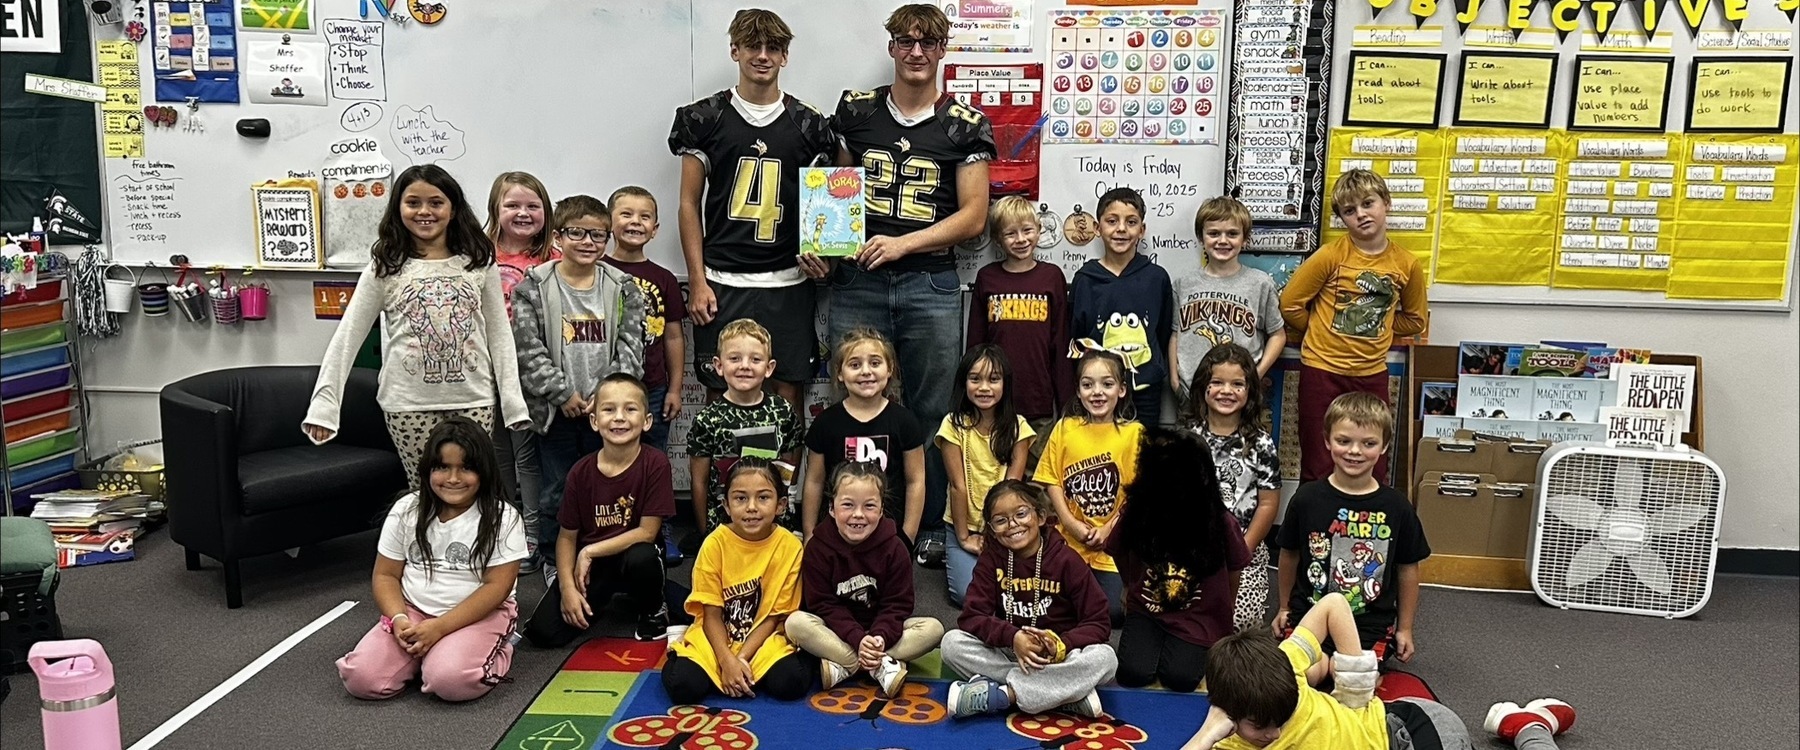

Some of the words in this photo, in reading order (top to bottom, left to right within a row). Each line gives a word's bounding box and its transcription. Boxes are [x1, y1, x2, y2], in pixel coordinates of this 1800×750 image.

[964, 4, 1006, 14] Summer
[326, 23, 358, 34] Change
[362, 25, 381, 38] your
[1250, 29, 1280, 42] gym
[1156, 32, 1164, 44] 2
[1180, 32, 1188, 44] 3
[1201, 32, 1210, 43] 4
[1370, 28, 1406, 46] Reading
[1604, 32, 1632, 48] Math
[1702, 33, 1734, 47] Science
[338, 42, 368, 60] Stop
[1244, 47, 1280, 57] snack
[1107, 52, 1114, 64] 7
[1130, 55, 1138, 68] 8
[1154, 54, 1162, 66] 9
[1175, 54, 1188, 66] 10
[1199, 56, 1212, 66] 11
[1358, 61, 1366, 70] I
[270, 64, 303, 72] Shaffer
[338, 62, 369, 74] Think
[1582, 66, 1592, 75] I
[1699, 68, 1710, 77] I
[340, 76, 374, 89] Choose
[1055, 78, 1068, 88] 12
[1078, 77, 1091, 88] 13
[1102, 78, 1115, 88] 14
[1127, 78, 1139, 90] 15
[1150, 78, 1163, 90] 16
[1173, 78, 1186, 90] 17
[1198, 78, 1211, 90] 18
[1247, 82, 1291, 92] calendar
[1358, 78, 1383, 86] read
[1391, 78, 1421, 87] about
[1503, 80, 1533, 89] about
[61, 81, 98, 98] Shaffer
[1584, 85, 1602, 93] use
[1611, 84, 1641, 96] place
[1702, 89, 1720, 98] use
[1729, 87, 1755, 97] tools
[1762, 87, 1771, 97] to
[1056, 100, 1068, 110] 19
[1077, 101, 1090, 111] 20
[1102, 101, 1114, 110] 21
[1124, 101, 1137, 112] 22
[1150, 101, 1162, 111] 23
[1172, 100, 1184, 111] 24
[1197, 102, 1210, 112] 25
[1250, 101, 1284, 110] math
[1577, 100, 1607, 110] value
[1614, 101, 1622, 109] to
[1630, 98, 1649, 110] add
[1696, 103, 1711, 114] do
[396, 113, 430, 130] Lunch
[1259, 118, 1289, 128] lunch
[1054, 122, 1067, 133] 26
[1078, 123, 1090, 134] 27
[1101, 122, 1114, 133] 28
[1123, 122, 1136, 133] 29
[1146, 122, 1158, 134] 30
[1171, 122, 1184, 132] 31
[402, 131, 427, 145] with
[430, 130, 450, 142] the
[1245, 136, 1287, 146] recess
[331, 138, 377, 154] cookie
[412, 144, 448, 156] teacher
[1357, 138, 1394, 155] Vocabulary
[1464, 138, 1508, 154] Vocabulary
[1511, 139, 1537, 152] Words
[1582, 142, 1620, 156] Vocabulary
[1253, 151, 1282, 159] reading
[1701, 146, 1743, 160] Vocabulary
[1746, 147, 1769, 161] Words
[322, 163, 390, 176] compliments
[1074, 156, 1116, 178] Today
[1124, 162, 1133, 173] is
[1143, 155, 1181, 179] Friday
[1392, 162, 1414, 173] Work
[1453, 160, 1473, 172] Noun
[1243, 171, 1284, 180] recess
[154, 182, 175, 191] school
[829, 176, 859, 190] LORAX
[862, 149, 940, 222] 22
[1150, 184, 1161, 197] 10,
[1166, 184, 1198, 196] 2025
[1245, 188, 1282, 197] phonics
[728, 156, 784, 242] 4
[1501, 198, 1532, 209] Solution
[1271, 205, 1283, 214] up
[1252, 235, 1294, 247] writing
[1063, 250, 1087, 261] Penny
[321, 291, 328, 302] 1
[339, 292, 347, 302] 2
[1188, 291, 1249, 307] POTTERVILLE
[1180, 300, 1257, 338] VIKINGS
[1528, 359, 1577, 368] TOOLS
[1590, 356, 1624, 364] MATH
[1630, 375, 1650, 388] THE
[1654, 376, 1686, 389] LITTLE
[1470, 387, 1520, 398] MAGNIFICENT
[1537, 388, 1588, 400] MAGNIFICENT
[1628, 388, 1654, 408] RED
[1659, 390, 1684, 409] PEN
[1484, 398, 1505, 407] THING
[1551, 400, 1572, 409] THING
[1610, 417, 1629, 430] THE
[1633, 418, 1666, 432] LITTLE
[1337, 508, 1386, 524] SUPER
[1328, 519, 1392, 540] MARIO
